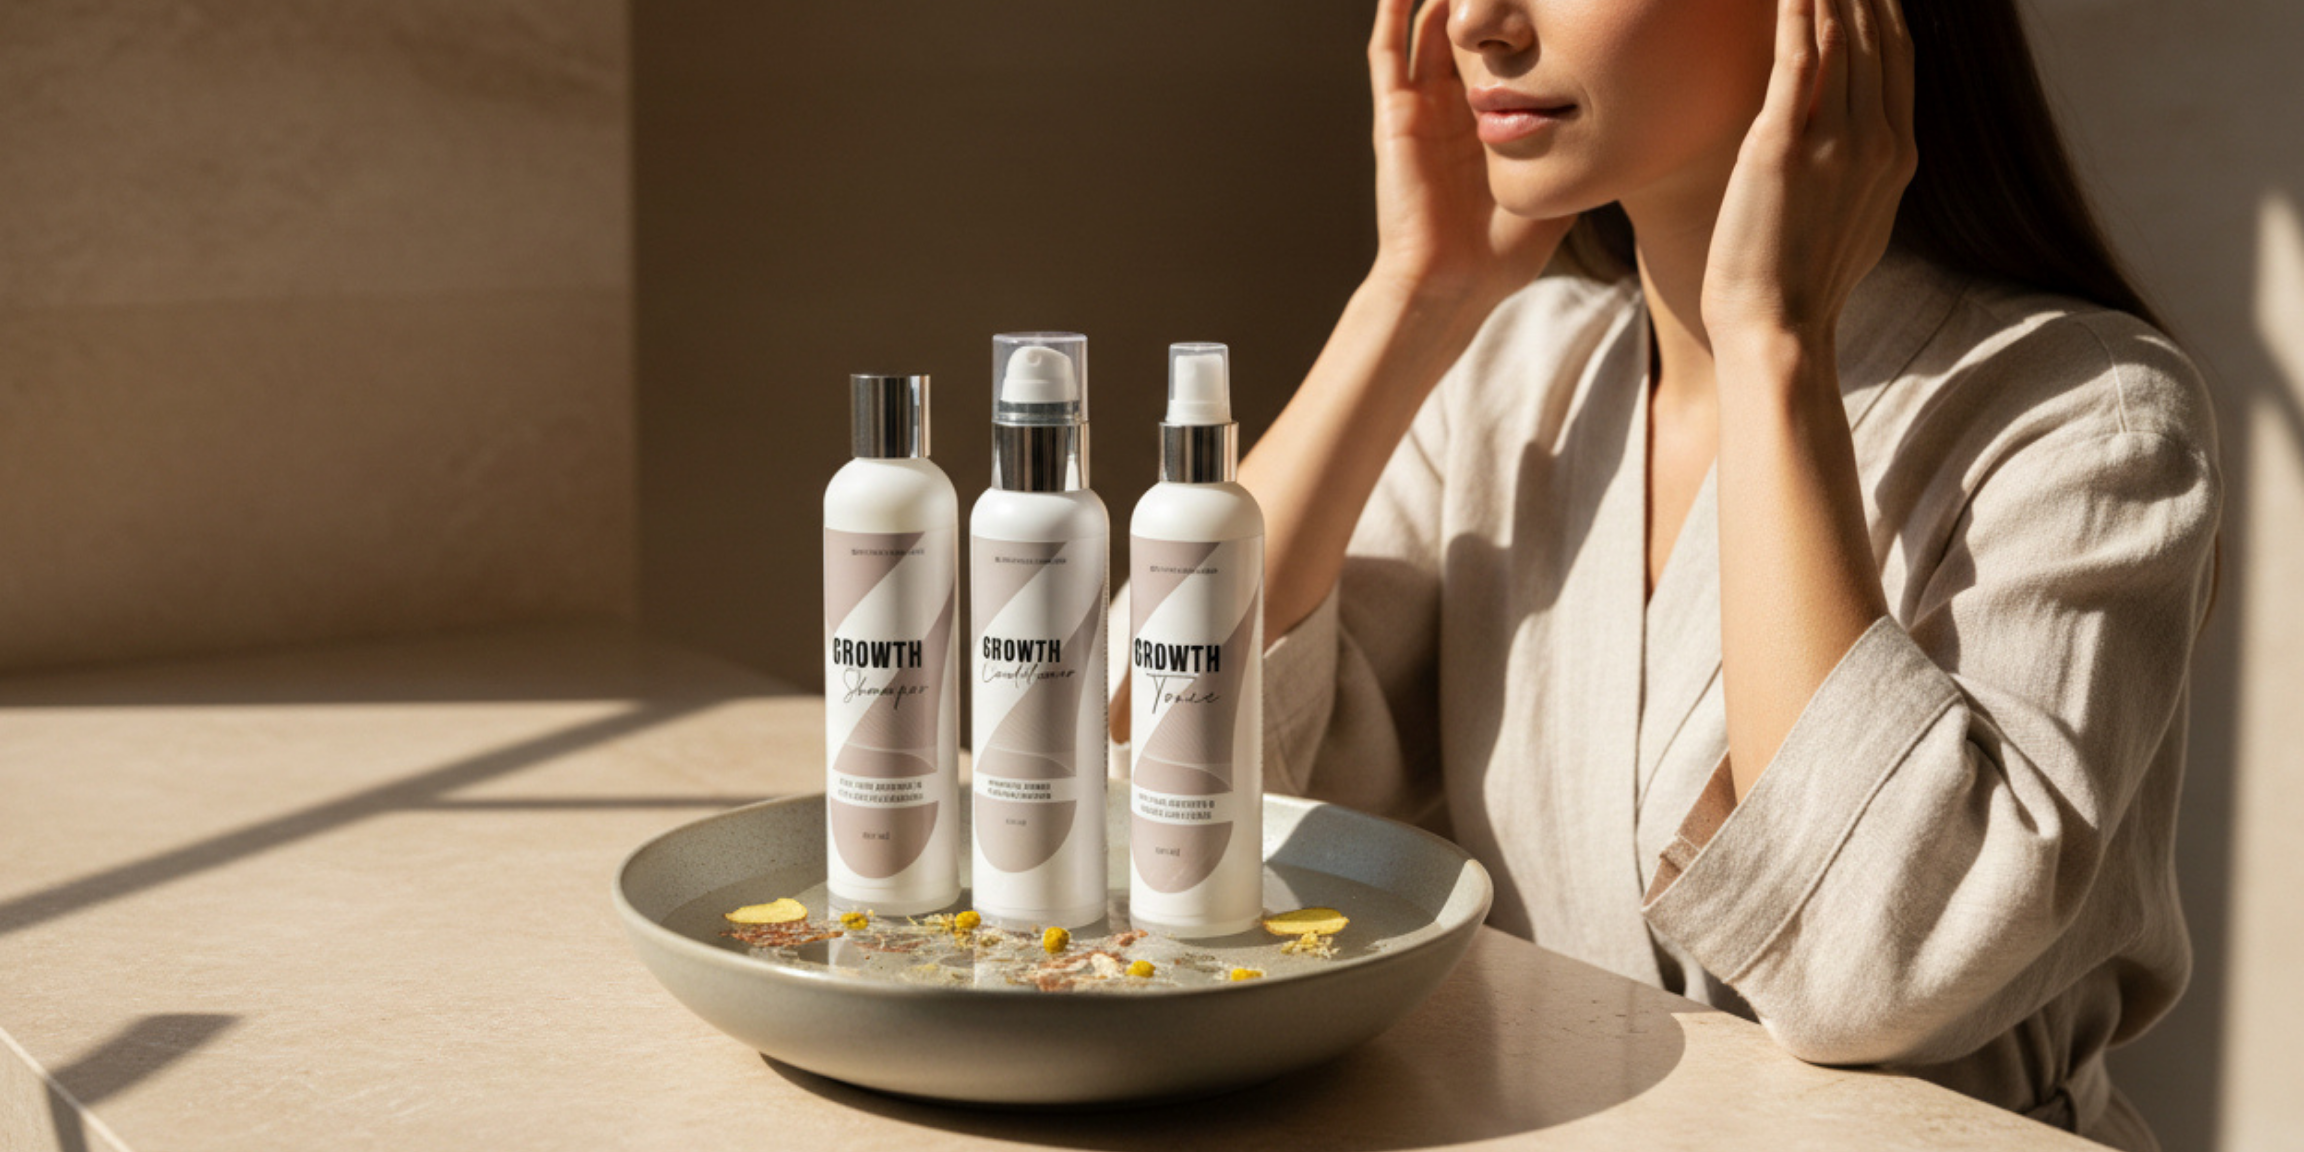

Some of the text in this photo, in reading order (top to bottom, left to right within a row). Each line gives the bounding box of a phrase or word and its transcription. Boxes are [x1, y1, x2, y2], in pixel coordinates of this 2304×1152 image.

[833, 637, 922, 668] GROWTH
[983, 636, 1061, 663] GROWTH
[1134, 637, 1220, 673] GROWTH
